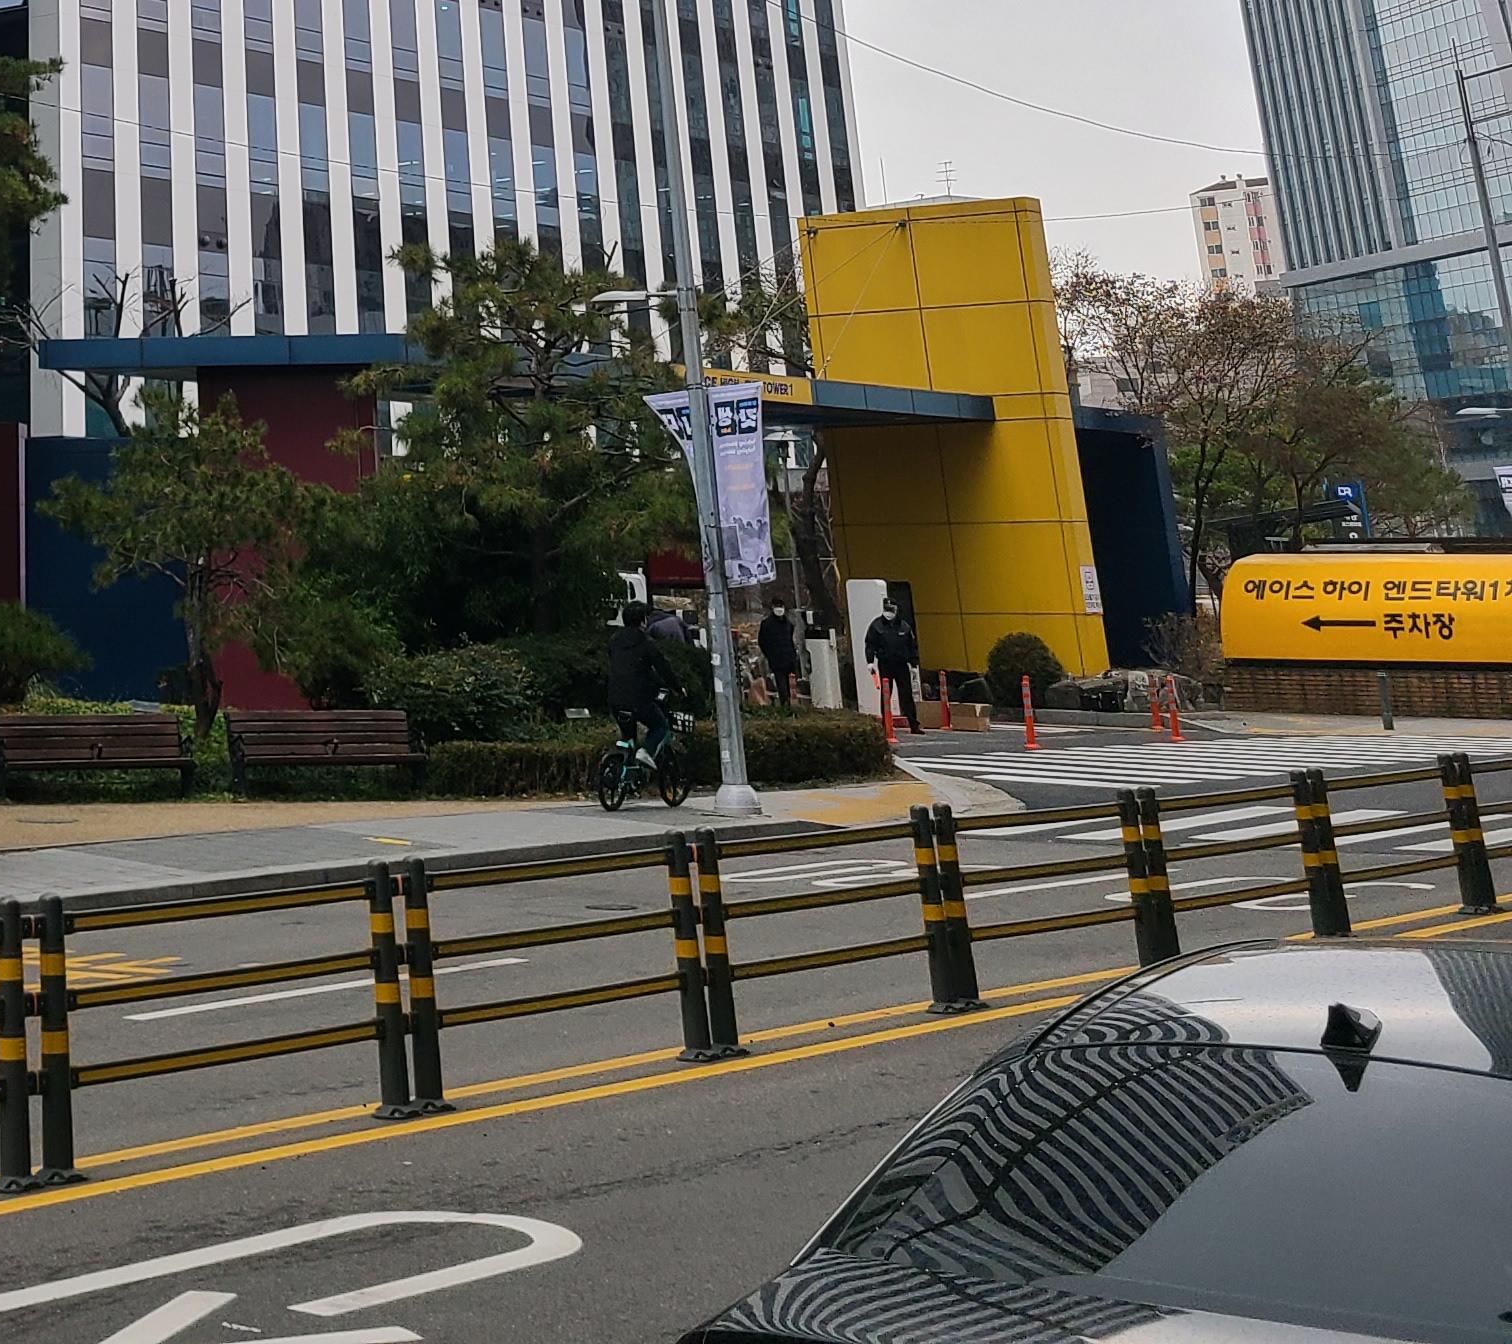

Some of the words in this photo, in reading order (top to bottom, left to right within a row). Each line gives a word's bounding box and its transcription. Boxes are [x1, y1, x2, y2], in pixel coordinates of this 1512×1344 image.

[1243, 579, 1315, 601] 에이스
[1322, 579, 1371, 601] 하이
[1383, 613, 1456, 640] 주차장
